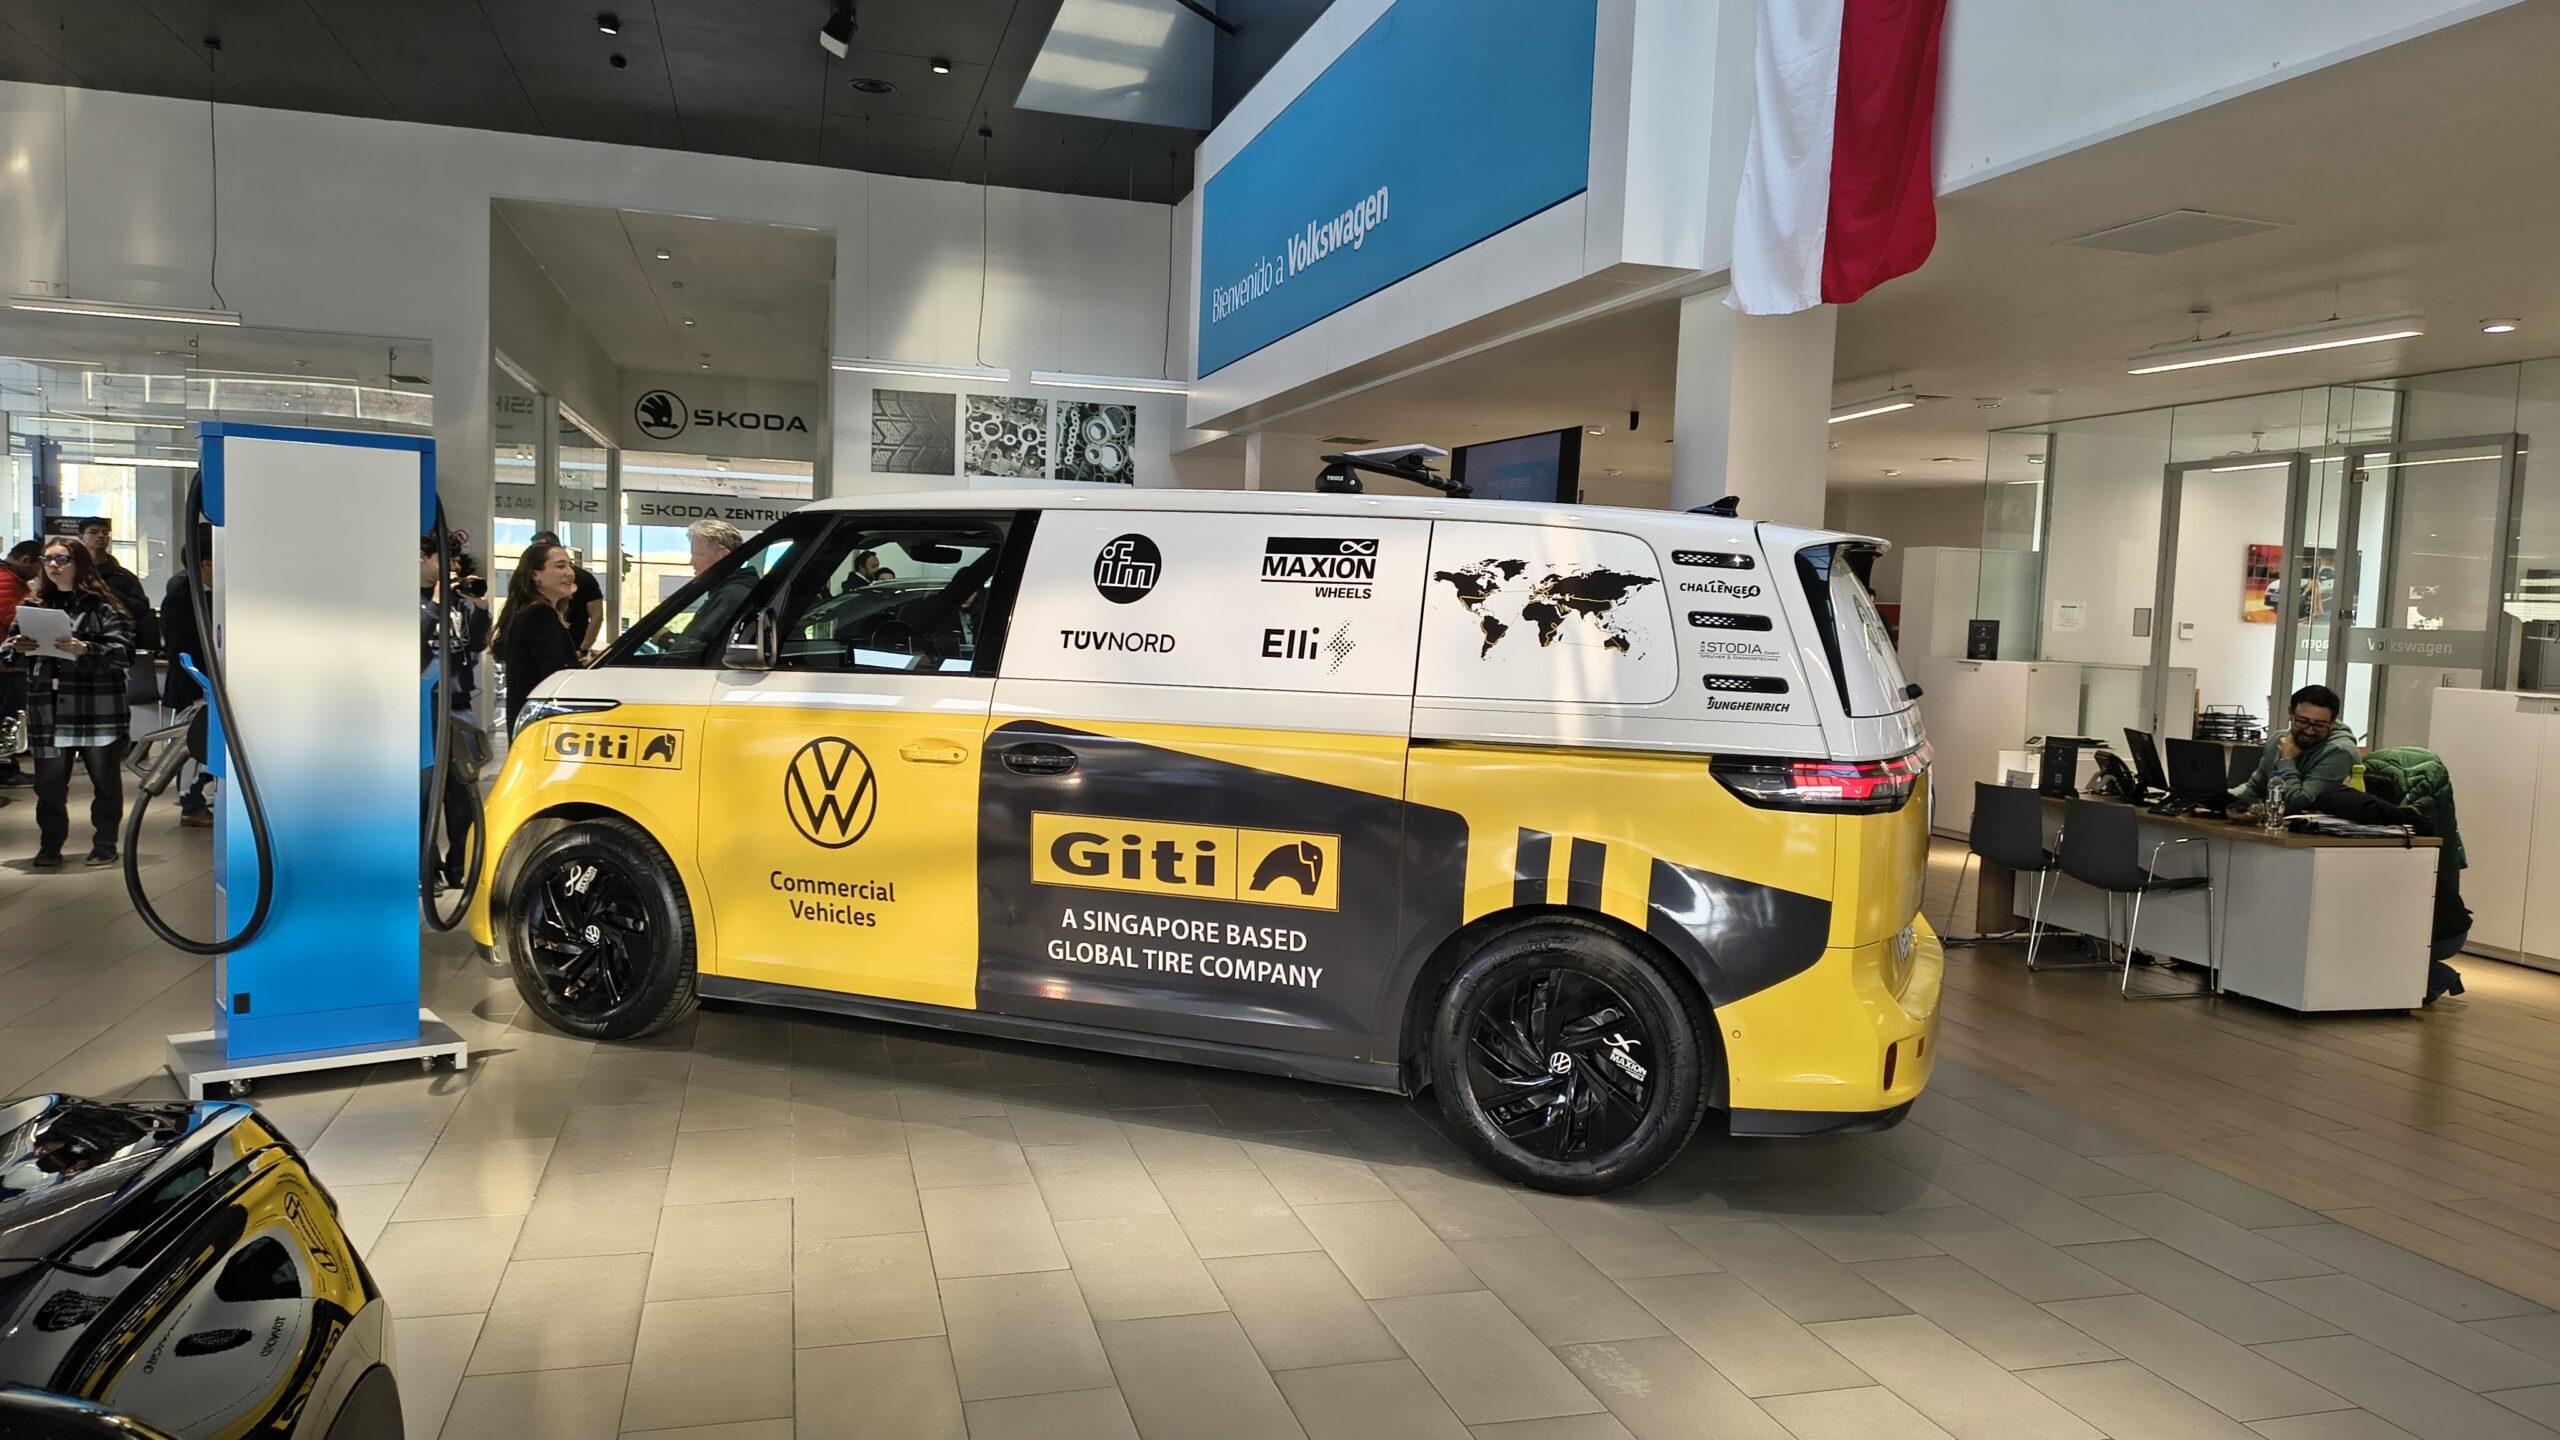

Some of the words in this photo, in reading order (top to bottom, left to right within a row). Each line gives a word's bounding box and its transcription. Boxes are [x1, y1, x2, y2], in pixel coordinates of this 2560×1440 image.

[1212, 255, 1273, 323] Bienvenido
[1275, 255, 1284, 286] a
[1287, 185, 1389, 277] Volkswagen
[1097, 540, 1156, 589] ifm
[1261, 555, 1376, 579] MAXION
[1315, 586, 1372, 600] WHEELS
[1261, 627, 1320, 660] Elli
[1706, 641, 1762, 654] STODIA
[2367, 637, 2453, 657] Volkswagen
[1707, 696, 1790, 713] JUNGHEINRICH
[554, 731, 629, 760] Giti
[1050, 831, 1217, 887] Giti
[770, 871, 896, 902] Commercial
[790, 899, 877, 927] Vehicles
[1062, 908, 1078, 929] A
[1083, 910, 1220, 944] SINGAPORE
[1226, 924, 1308, 952] BASED
[1048, 939, 1139, 969] GLOBAL
[1142, 948, 1194, 975] TIRE
[1199, 955, 1324, 989] COMPANY
[1610, 1052, 1648, 1077] MAXION
